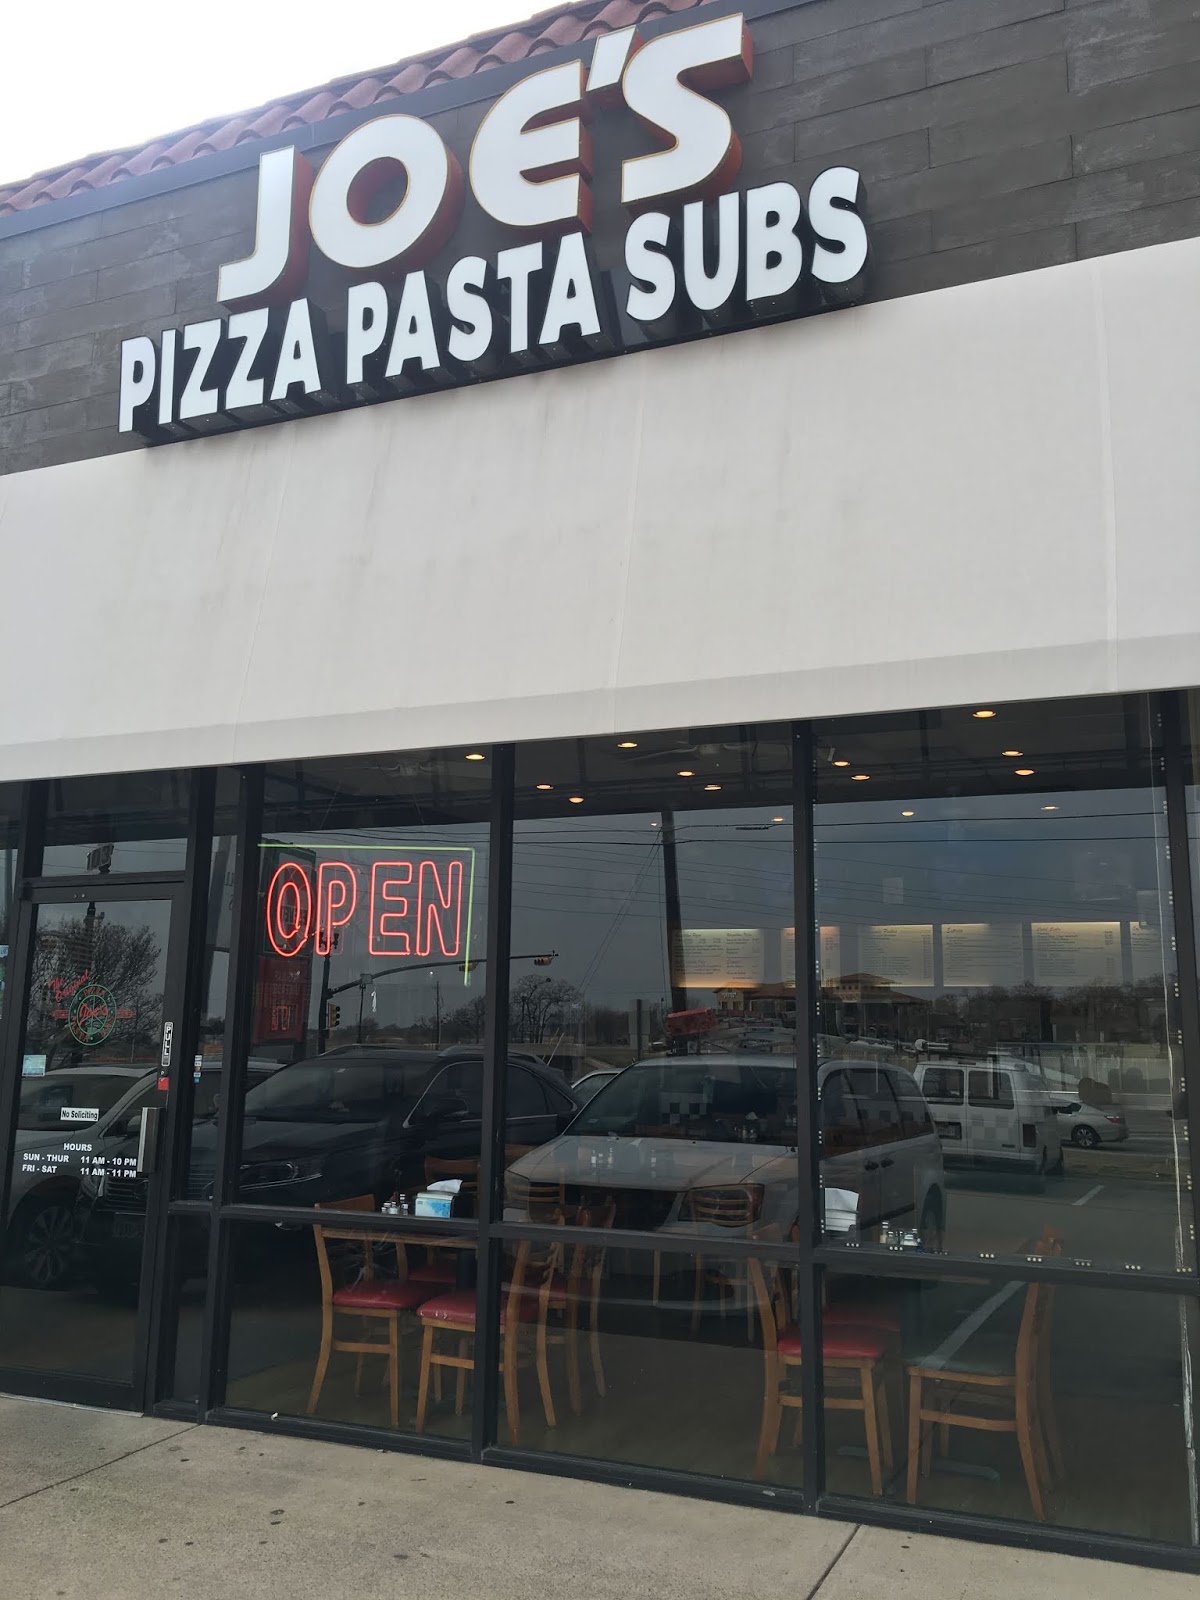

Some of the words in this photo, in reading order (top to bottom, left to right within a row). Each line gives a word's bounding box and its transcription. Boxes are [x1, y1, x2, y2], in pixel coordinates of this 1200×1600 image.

[217, 13, 745, 303] JOE'S
[119, 298, 322, 433] PIZZA
[346, 232, 602, 385] PASTA
[624, 167, 868, 322] SUBS
[267, 861, 463, 957] OPEN
[164, 1026, 172, 1056] PULL
[61, 1110, 70, 1118] No
[71, 1110, 98, 1120] Soliciting
[63, 1142, 92, 1151] HOURS
[23, 1153, 40, 1161] SUN
[46, 1154, 69, 1163] THUR
[80, 1156, 89, 1164] 11
[92, 1156, 105, 1165] AM
[112, 1157, 122, 1165] 10
[123, 1157, 137, 1166] PM
[22, 1164, 35, 1172] FRI
[41, 1165, 57, 1173] SAT
[80, 1167, 89, 1175] 11
[91, 1168, 105, 1176] AM
[111, 1169, 122, 1177] 11
[123, 1169, 137, 1178] PM
